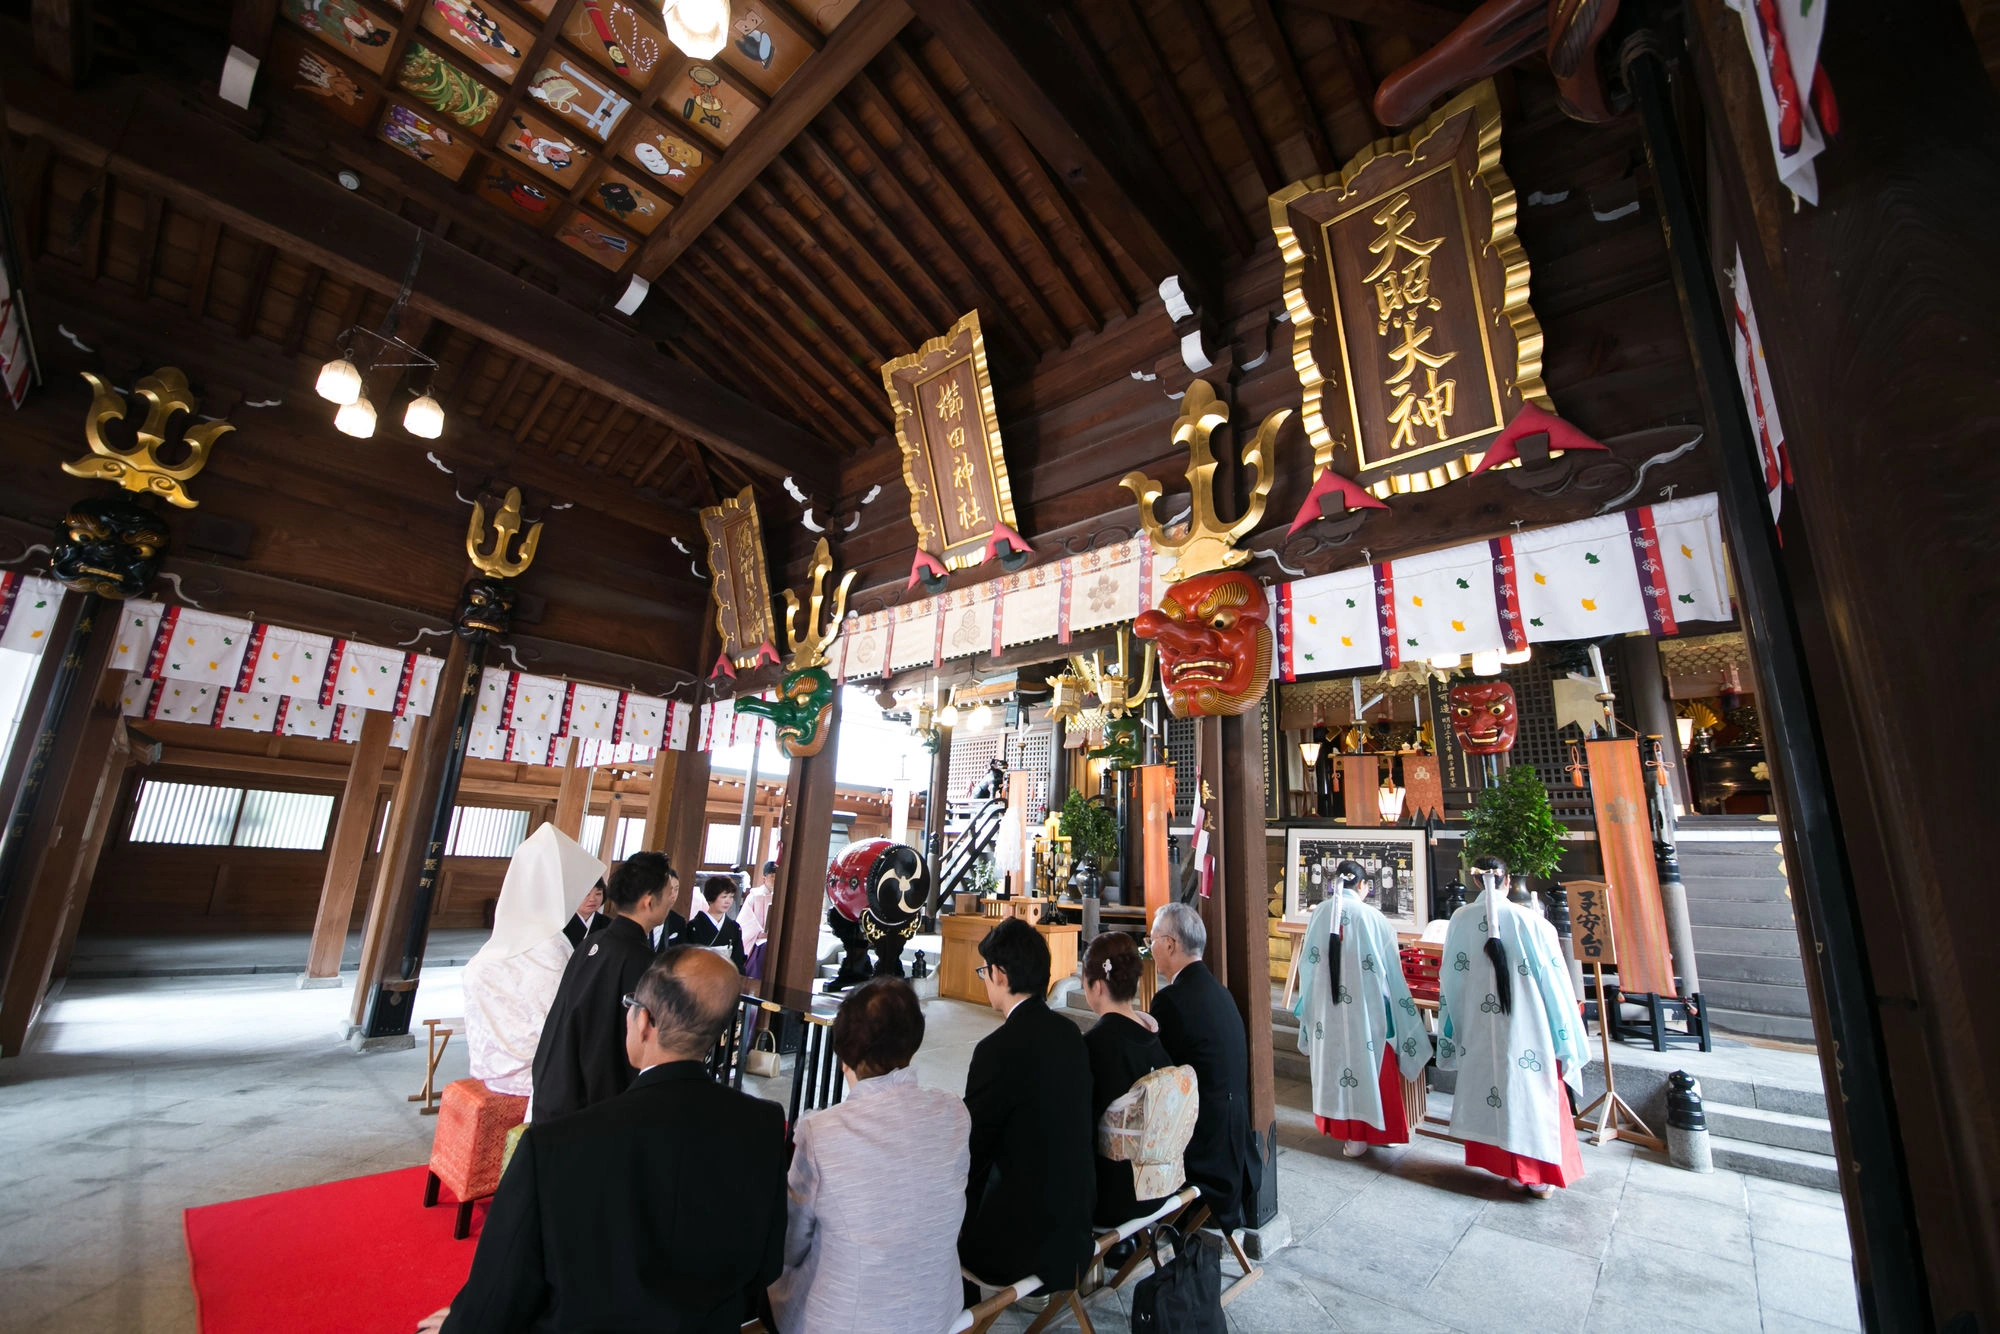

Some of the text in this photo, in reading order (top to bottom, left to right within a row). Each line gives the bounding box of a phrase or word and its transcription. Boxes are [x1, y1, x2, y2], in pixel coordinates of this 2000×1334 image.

[1361, 191, 1458, 450] 天照大神
[935, 379, 986, 530] 櫛田神社
